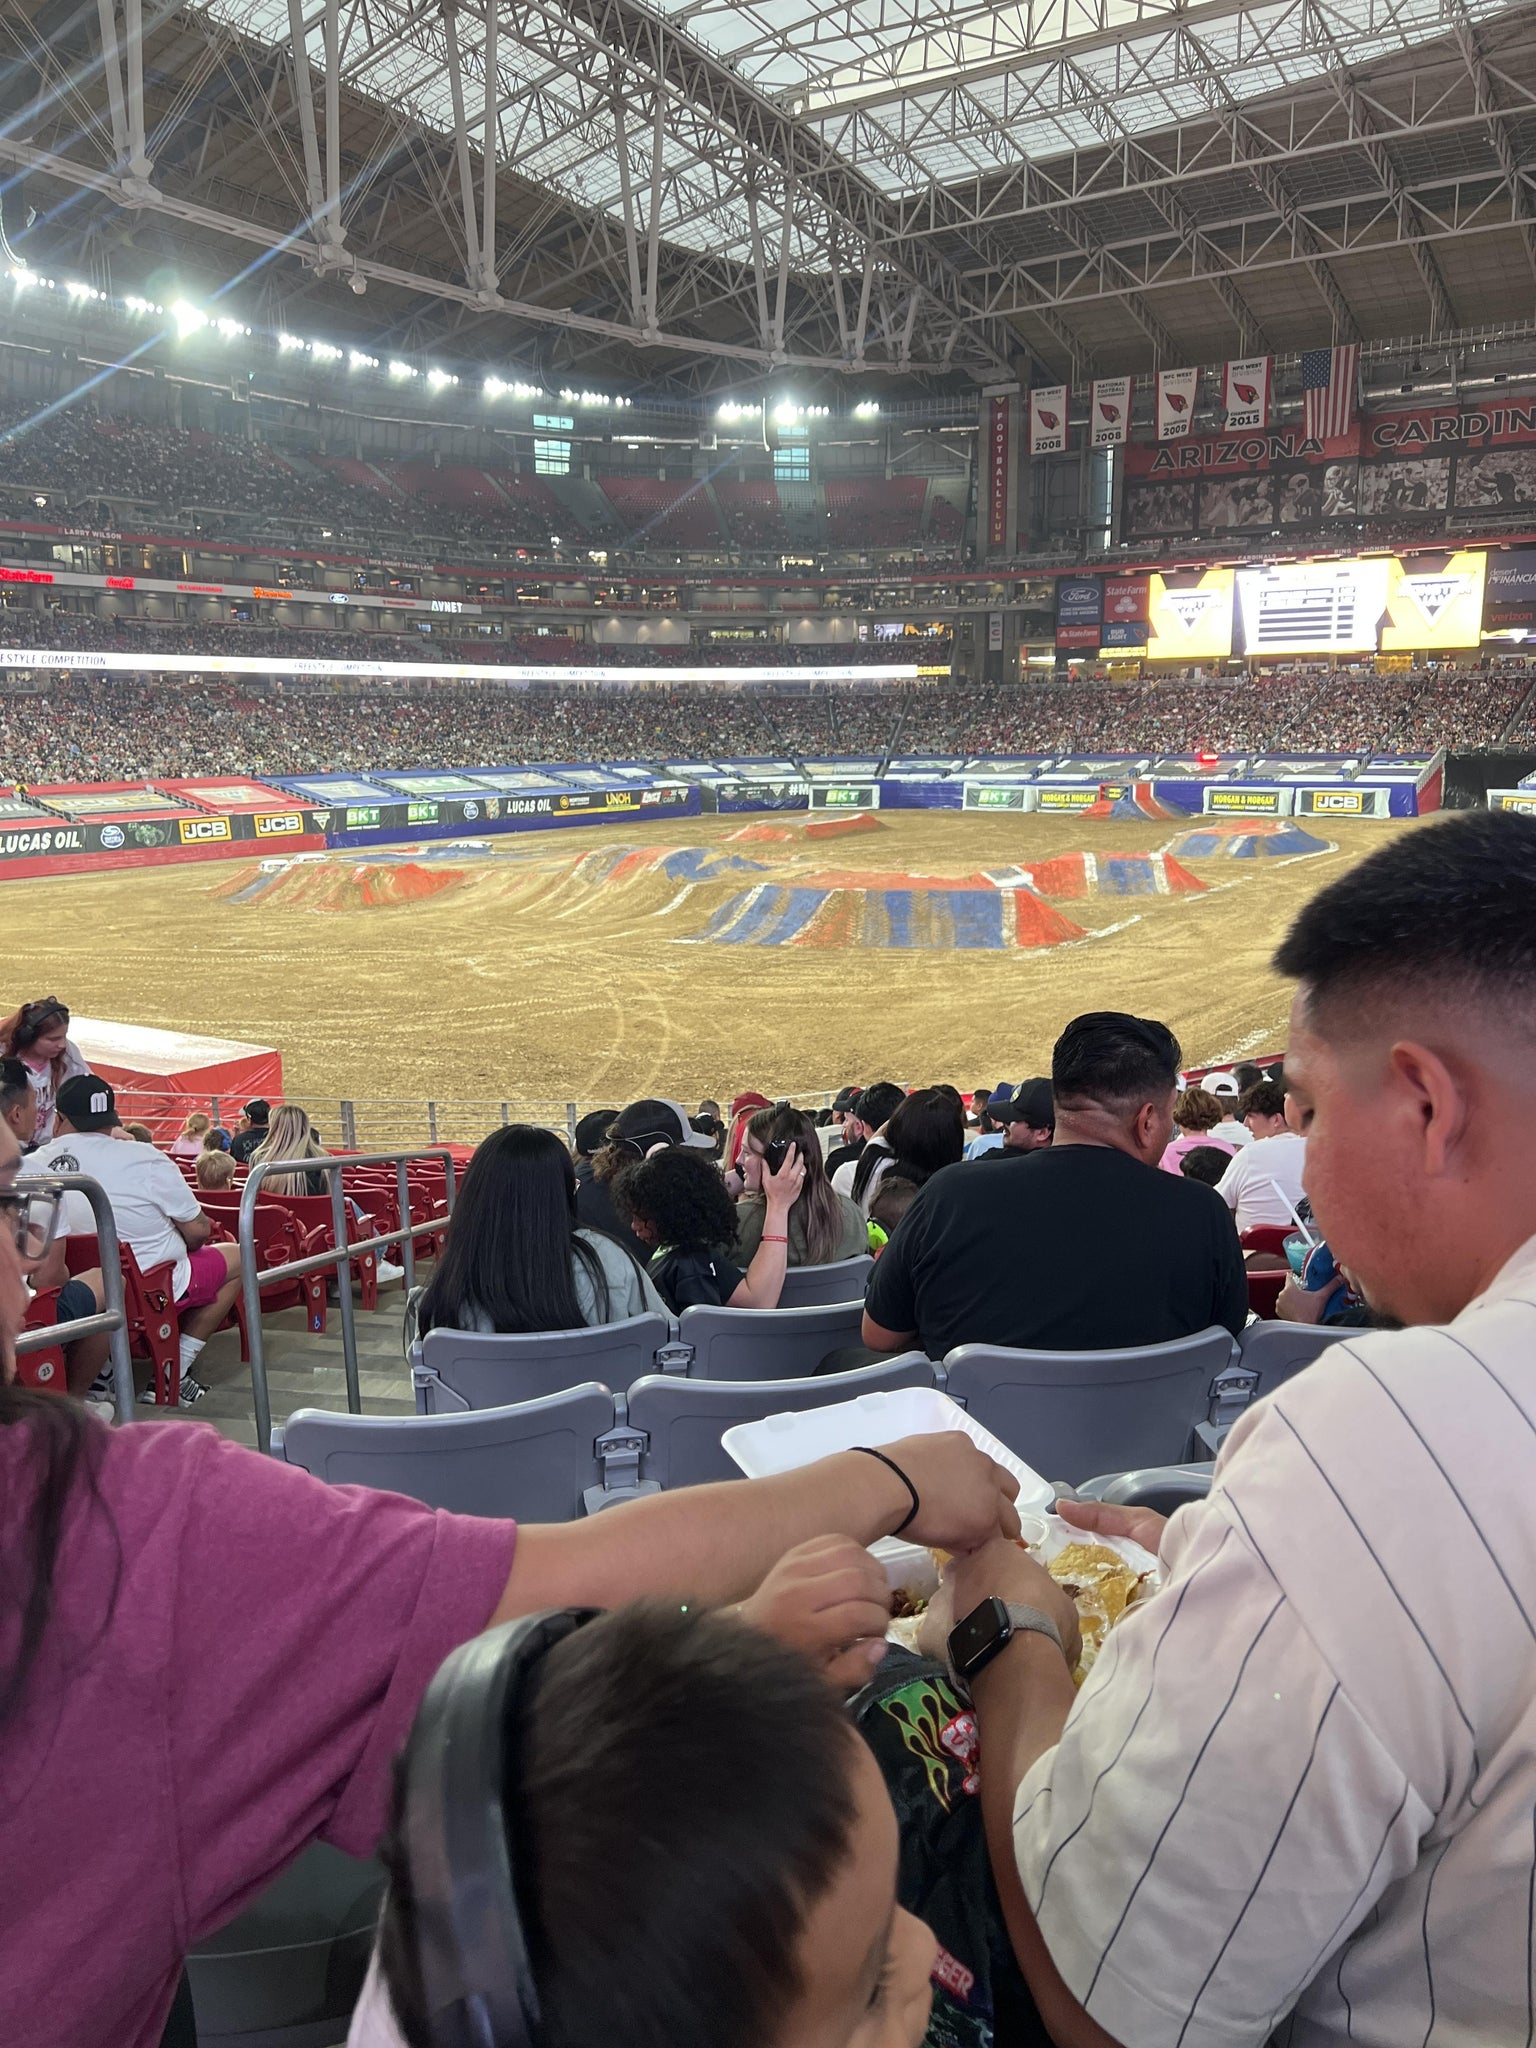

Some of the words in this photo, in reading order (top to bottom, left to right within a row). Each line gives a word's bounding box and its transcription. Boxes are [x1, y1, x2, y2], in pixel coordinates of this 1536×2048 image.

[1246, 362, 1262, 370] WEST
[1229, 414, 1260, 427] 2015
[1095, 431, 1122, 442] 2008
[1163, 424, 1187, 437] 2009
[1035, 440, 1062, 451] 2008
[1151, 434, 1325, 472] ARIZONA
[64, 527, 91, 538] LARRY
[92, 530, 122, 540] WILSON
[1067, 588, 1093, 601] Ford
[1491, 611, 1533, 622] verizon
[41, 655, 107, 667] COMPETITION
[605, 792, 632, 805] UNOH
[1042, 793, 1065, 804] MORGAN
[1071, 793, 1095, 804] MORGAN
[1213, 794, 1240, 805] MORGAN
[1240, 794, 1246, 804] &
[1246, 794, 1276, 806] MORGAN
[1317, 796, 1358, 809] JCB
[409, 804, 438, 820] BKT
[507, 800, 536, 814] LUCAS
[348, 808, 379, 825] BKT
[184, 821, 228, 839] JCB
[259, 816, 300, 833] JCB
[0, 831, 52, 854] LUCAS
[42, 1366, 51, 1377] 23
